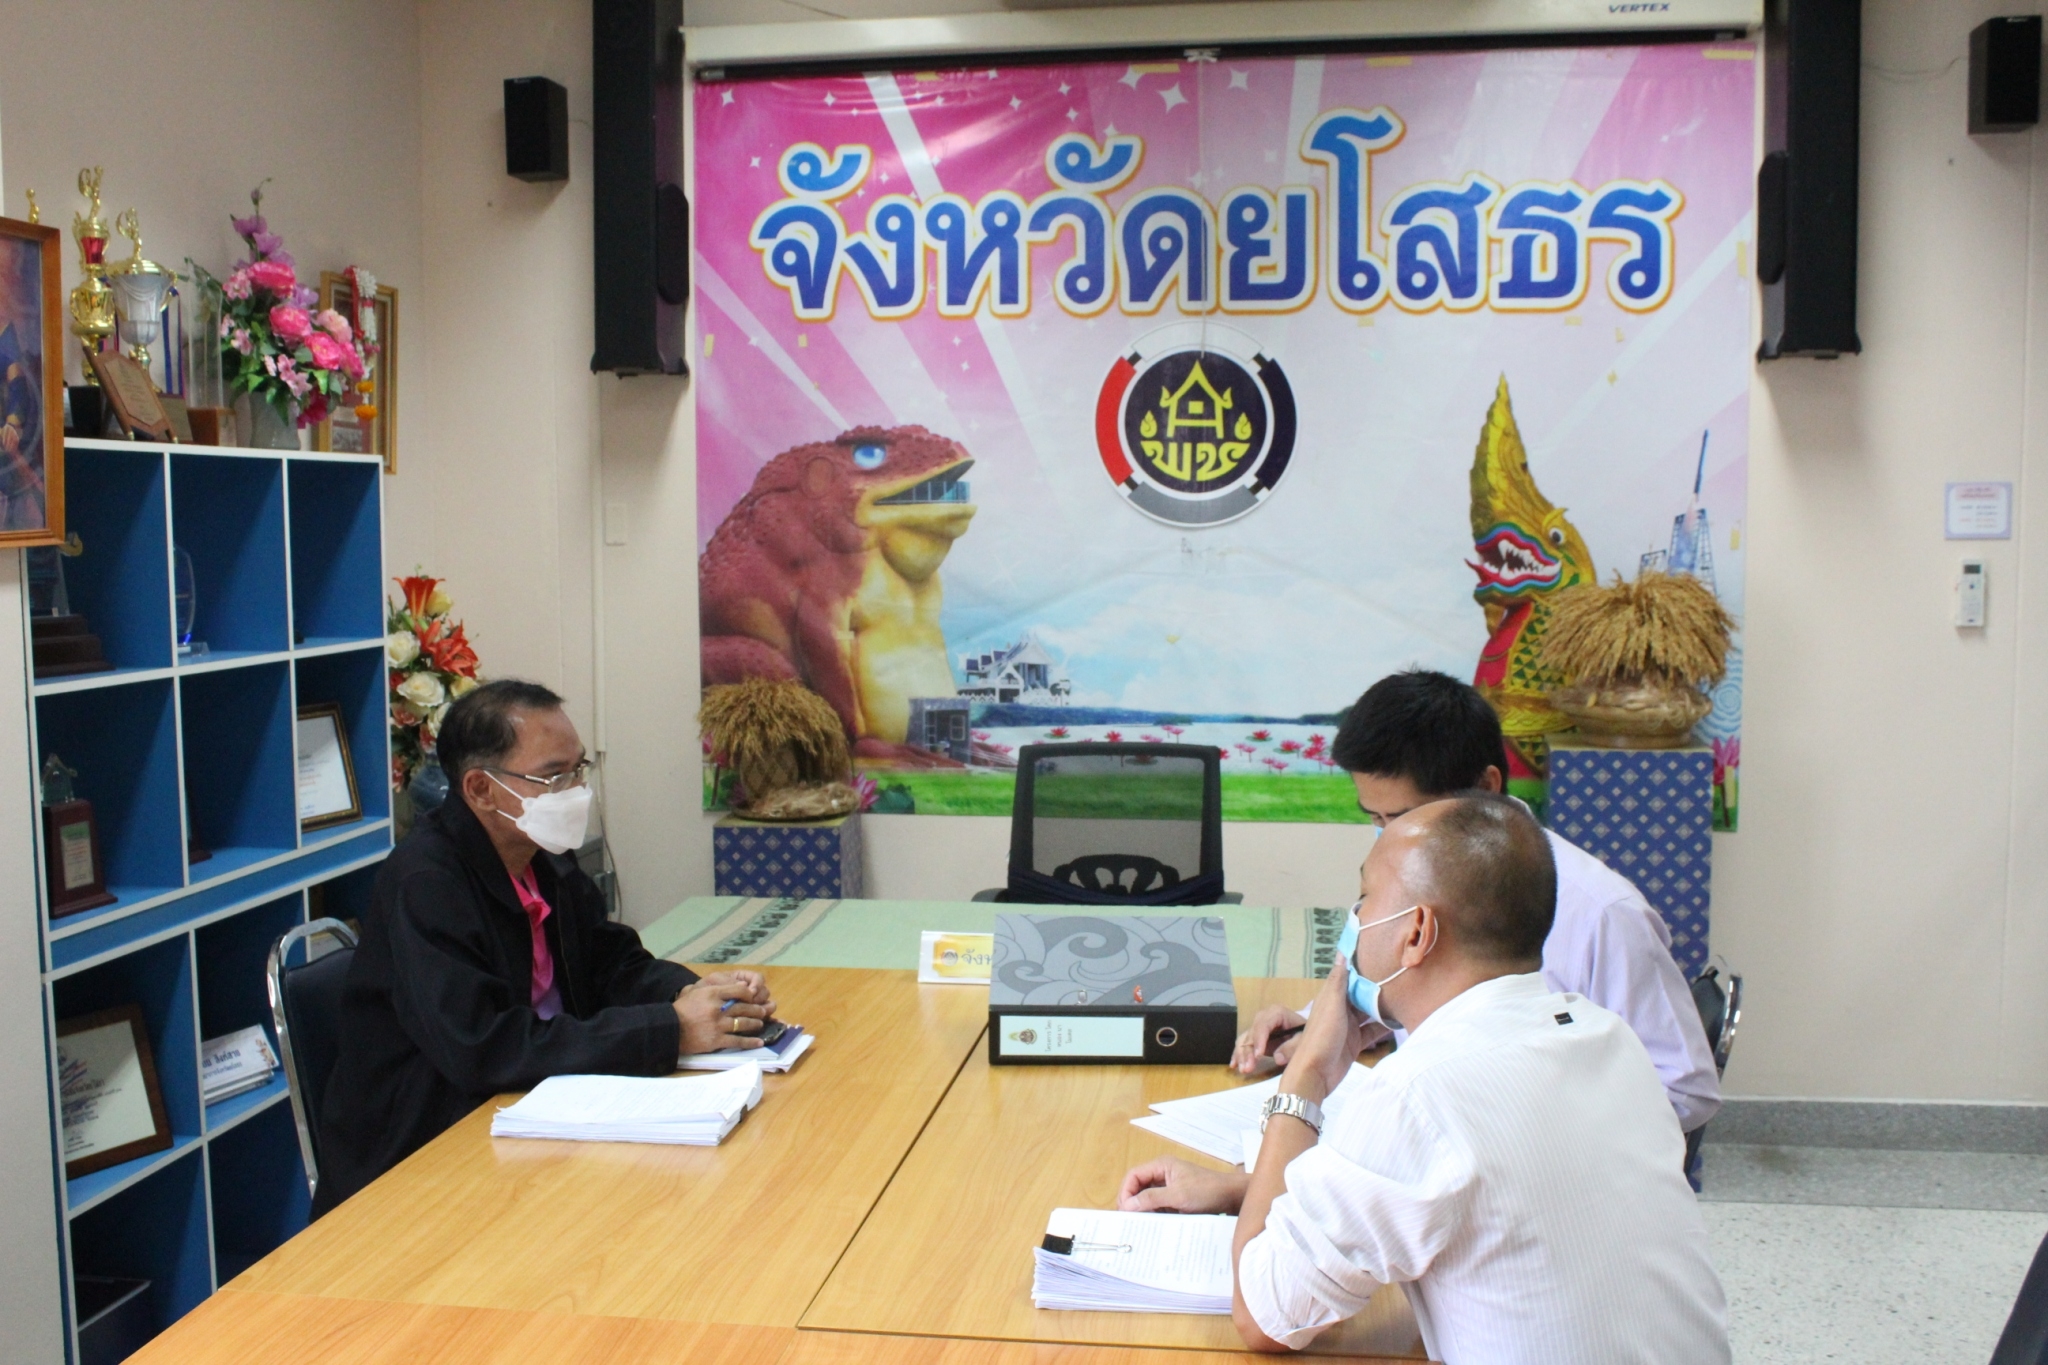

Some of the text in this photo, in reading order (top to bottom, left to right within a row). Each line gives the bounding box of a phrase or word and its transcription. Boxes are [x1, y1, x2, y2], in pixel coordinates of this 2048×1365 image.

[1608, 2, 1671, 13] VERTEX
[752, 108, 1682, 318] จังหวัดยโสธร
